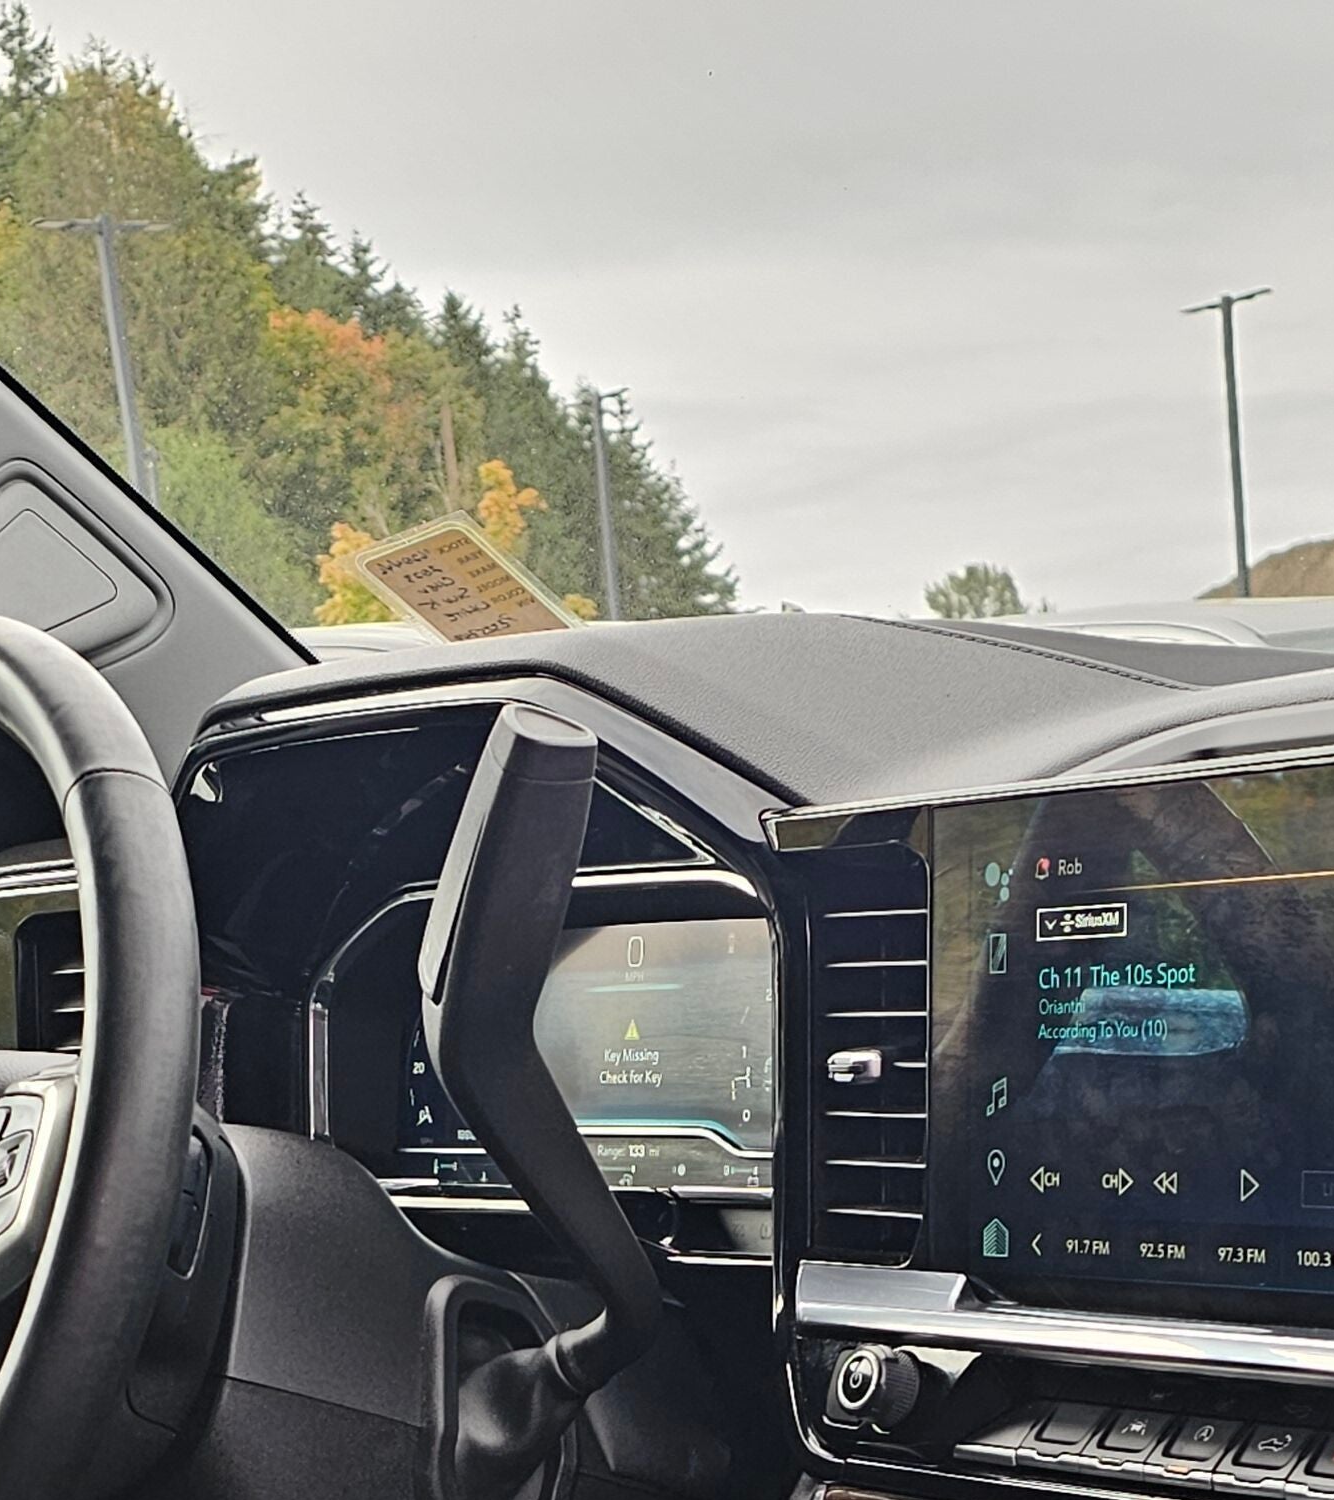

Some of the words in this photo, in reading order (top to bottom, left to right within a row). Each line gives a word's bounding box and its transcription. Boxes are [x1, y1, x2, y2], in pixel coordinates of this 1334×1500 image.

[1058, 859, 1082, 876] Rob
[1075, 912, 1119, 928] SiriusXM
[627, 936, 644, 968] 0
[1038, 966, 1060, 989] Ch
[1066, 967, 1082, 986] 11
[1090, 965, 1120, 986] The
[1124, 964, 1153, 986] 10s
[1156, 963, 1196, 989] Spot
[1038, 997, 1086, 1016] Orianthi
[1038, 1022, 1096, 1042] According
[1098, 1021, 1113, 1036] To
[1114, 1020, 1138, 1037] You
[1141, 1019, 1168, 1041] (10)
[604, 1049, 622, 1066] Key
[622, 1048, 659, 1066] Missing
[412, 1061, 426, 1075] 20
[599, 1070, 627, 1085] Check
[629, 1069, 643, 1084] for
[644, 1071, 663, 1088] Key
[1045, 1172, 1060, 1187] CH
[1102, 1173, 1118, 1189] CH
[1066, 1239, 1090, 1254] 91.7
[1092, 1240, 1110, 1255] FM
[1140, 1243, 1165, 1258] 92.5
[1167, 1244, 1186, 1260] FM
[1218, 1247, 1244, 1263] 97.3
[1246, 1248, 1266, 1264] FM
[1297, 1250, 1331, 1267] 100.3
